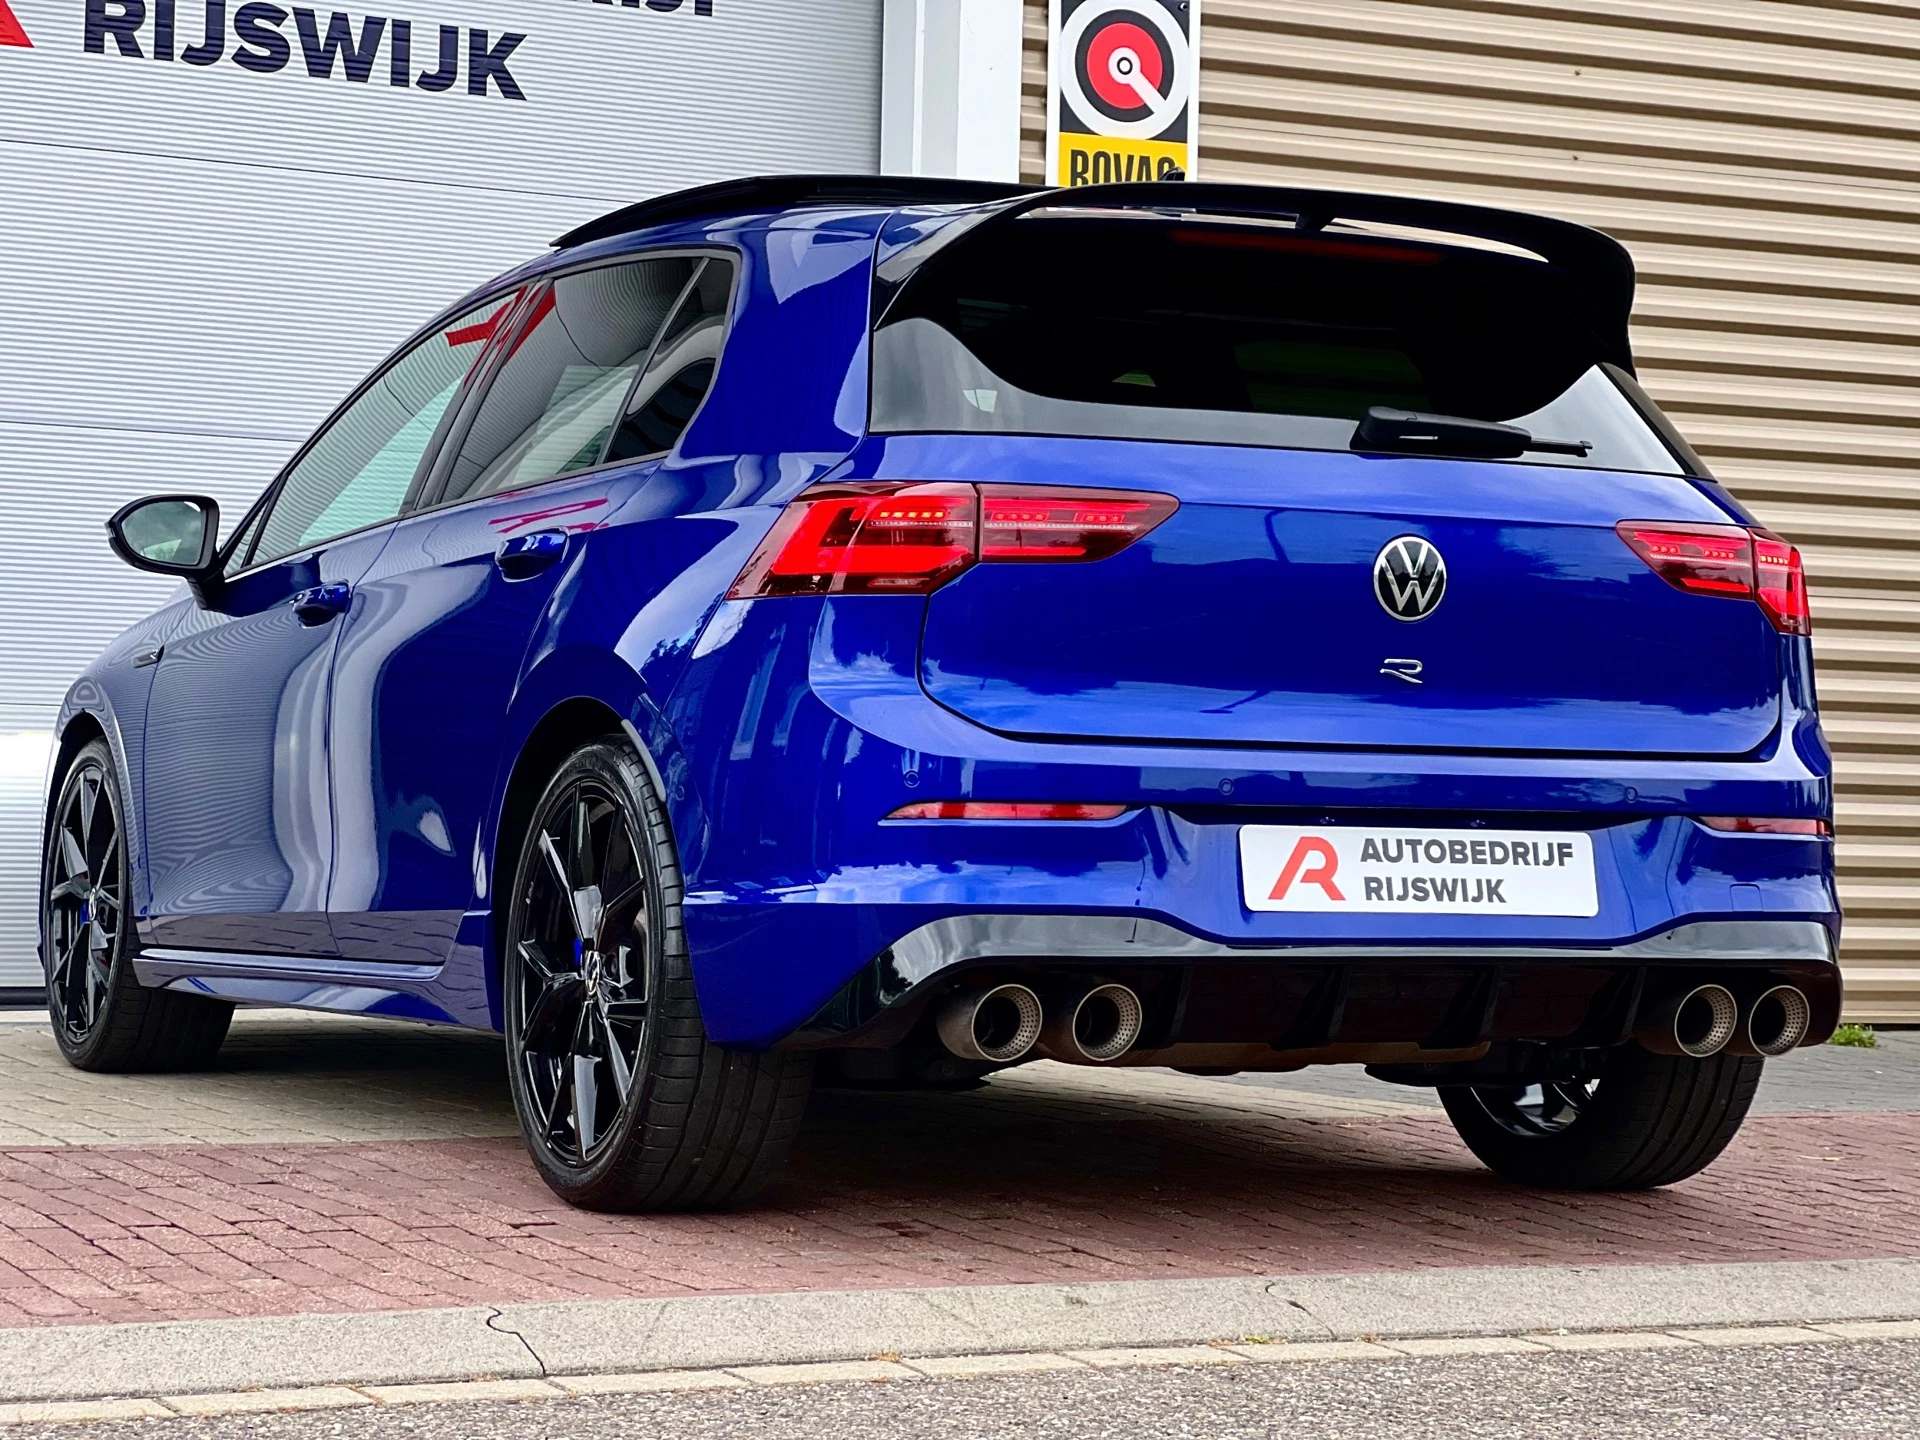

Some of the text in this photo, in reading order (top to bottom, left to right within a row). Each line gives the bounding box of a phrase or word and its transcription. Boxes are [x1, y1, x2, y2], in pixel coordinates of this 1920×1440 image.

[84, 0, 527, 100] RIJSWIJK
[1380, 658, 1423, 683] R
[1361, 838, 1573, 867] AUTOBEDRIJF
[1364, 877, 1506, 903] RIJSWIJK
